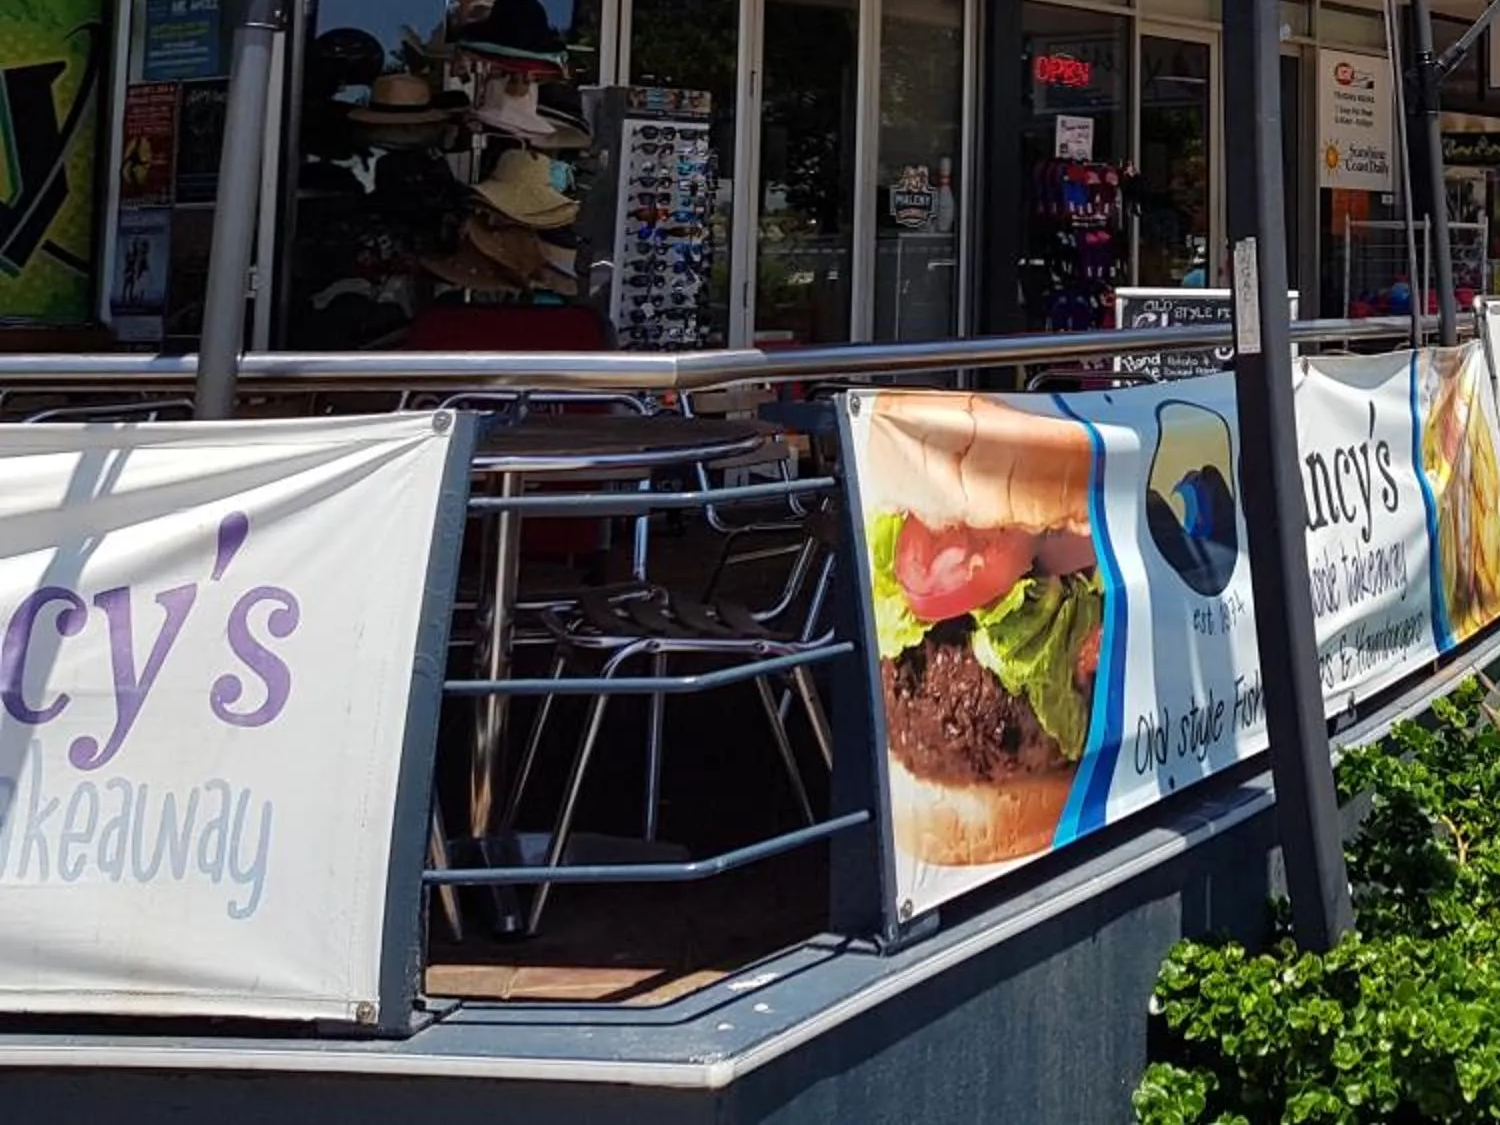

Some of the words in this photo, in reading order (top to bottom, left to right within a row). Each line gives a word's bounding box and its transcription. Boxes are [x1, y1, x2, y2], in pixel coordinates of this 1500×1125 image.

[1035, 55, 1089, 86] OPEN
[1304, 400, 1399, 543] ncy's
[1342, 540, 1408, 601] takeaway
[0, 511, 301, 771] cy's
[1135, 707, 1169, 775] Old
[1177, 688, 1225, 762] style
[0, 739, 273, 920] keaway
